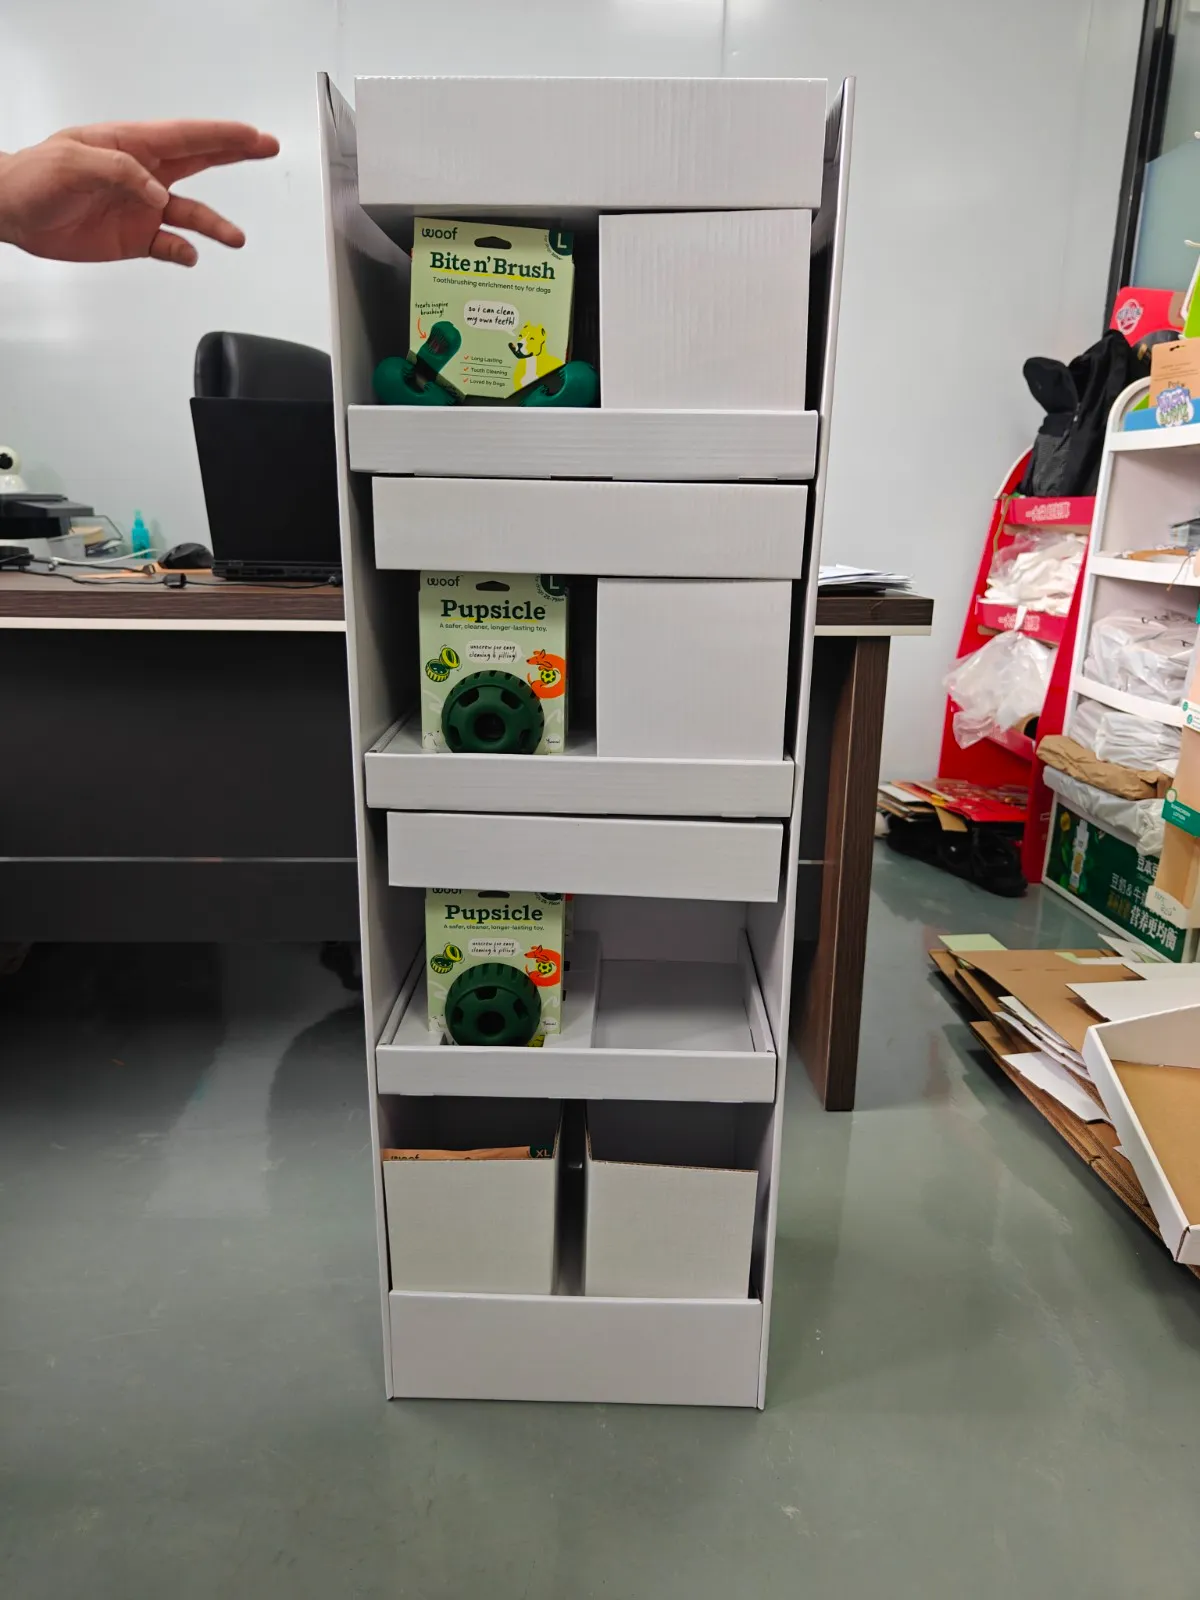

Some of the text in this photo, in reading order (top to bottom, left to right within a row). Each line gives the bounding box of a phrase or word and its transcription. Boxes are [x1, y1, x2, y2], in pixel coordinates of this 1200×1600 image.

[422, 227, 458, 240] woof
[557, 233, 567, 248] L
[430, 252, 470, 271] Bite
[493, 258, 555, 279] Brush
[433, 276, 477, 288] Toothbrushing
[478, 281, 513, 290] enrichment
[514, 284, 524, 292] toy
[536, 286, 551, 294] dogs
[496, 306, 514, 315] clean
[467, 316, 478, 325] my
[495, 317, 515, 325] teeth!
[427, 576, 460, 586] woof
[550, 576, 559, 590] L
[441, 599, 546, 623] Pupsicle
[490, 624, 535, 632] longer-lasting
[536, 625, 547, 633] toy.
[469, 651, 491, 661] cleaning
[445, 904, 543, 924] Pupsicle
[1130, 905, 1178, 951] 营养更均衡
[536, 1149, 550, 1158] XL
